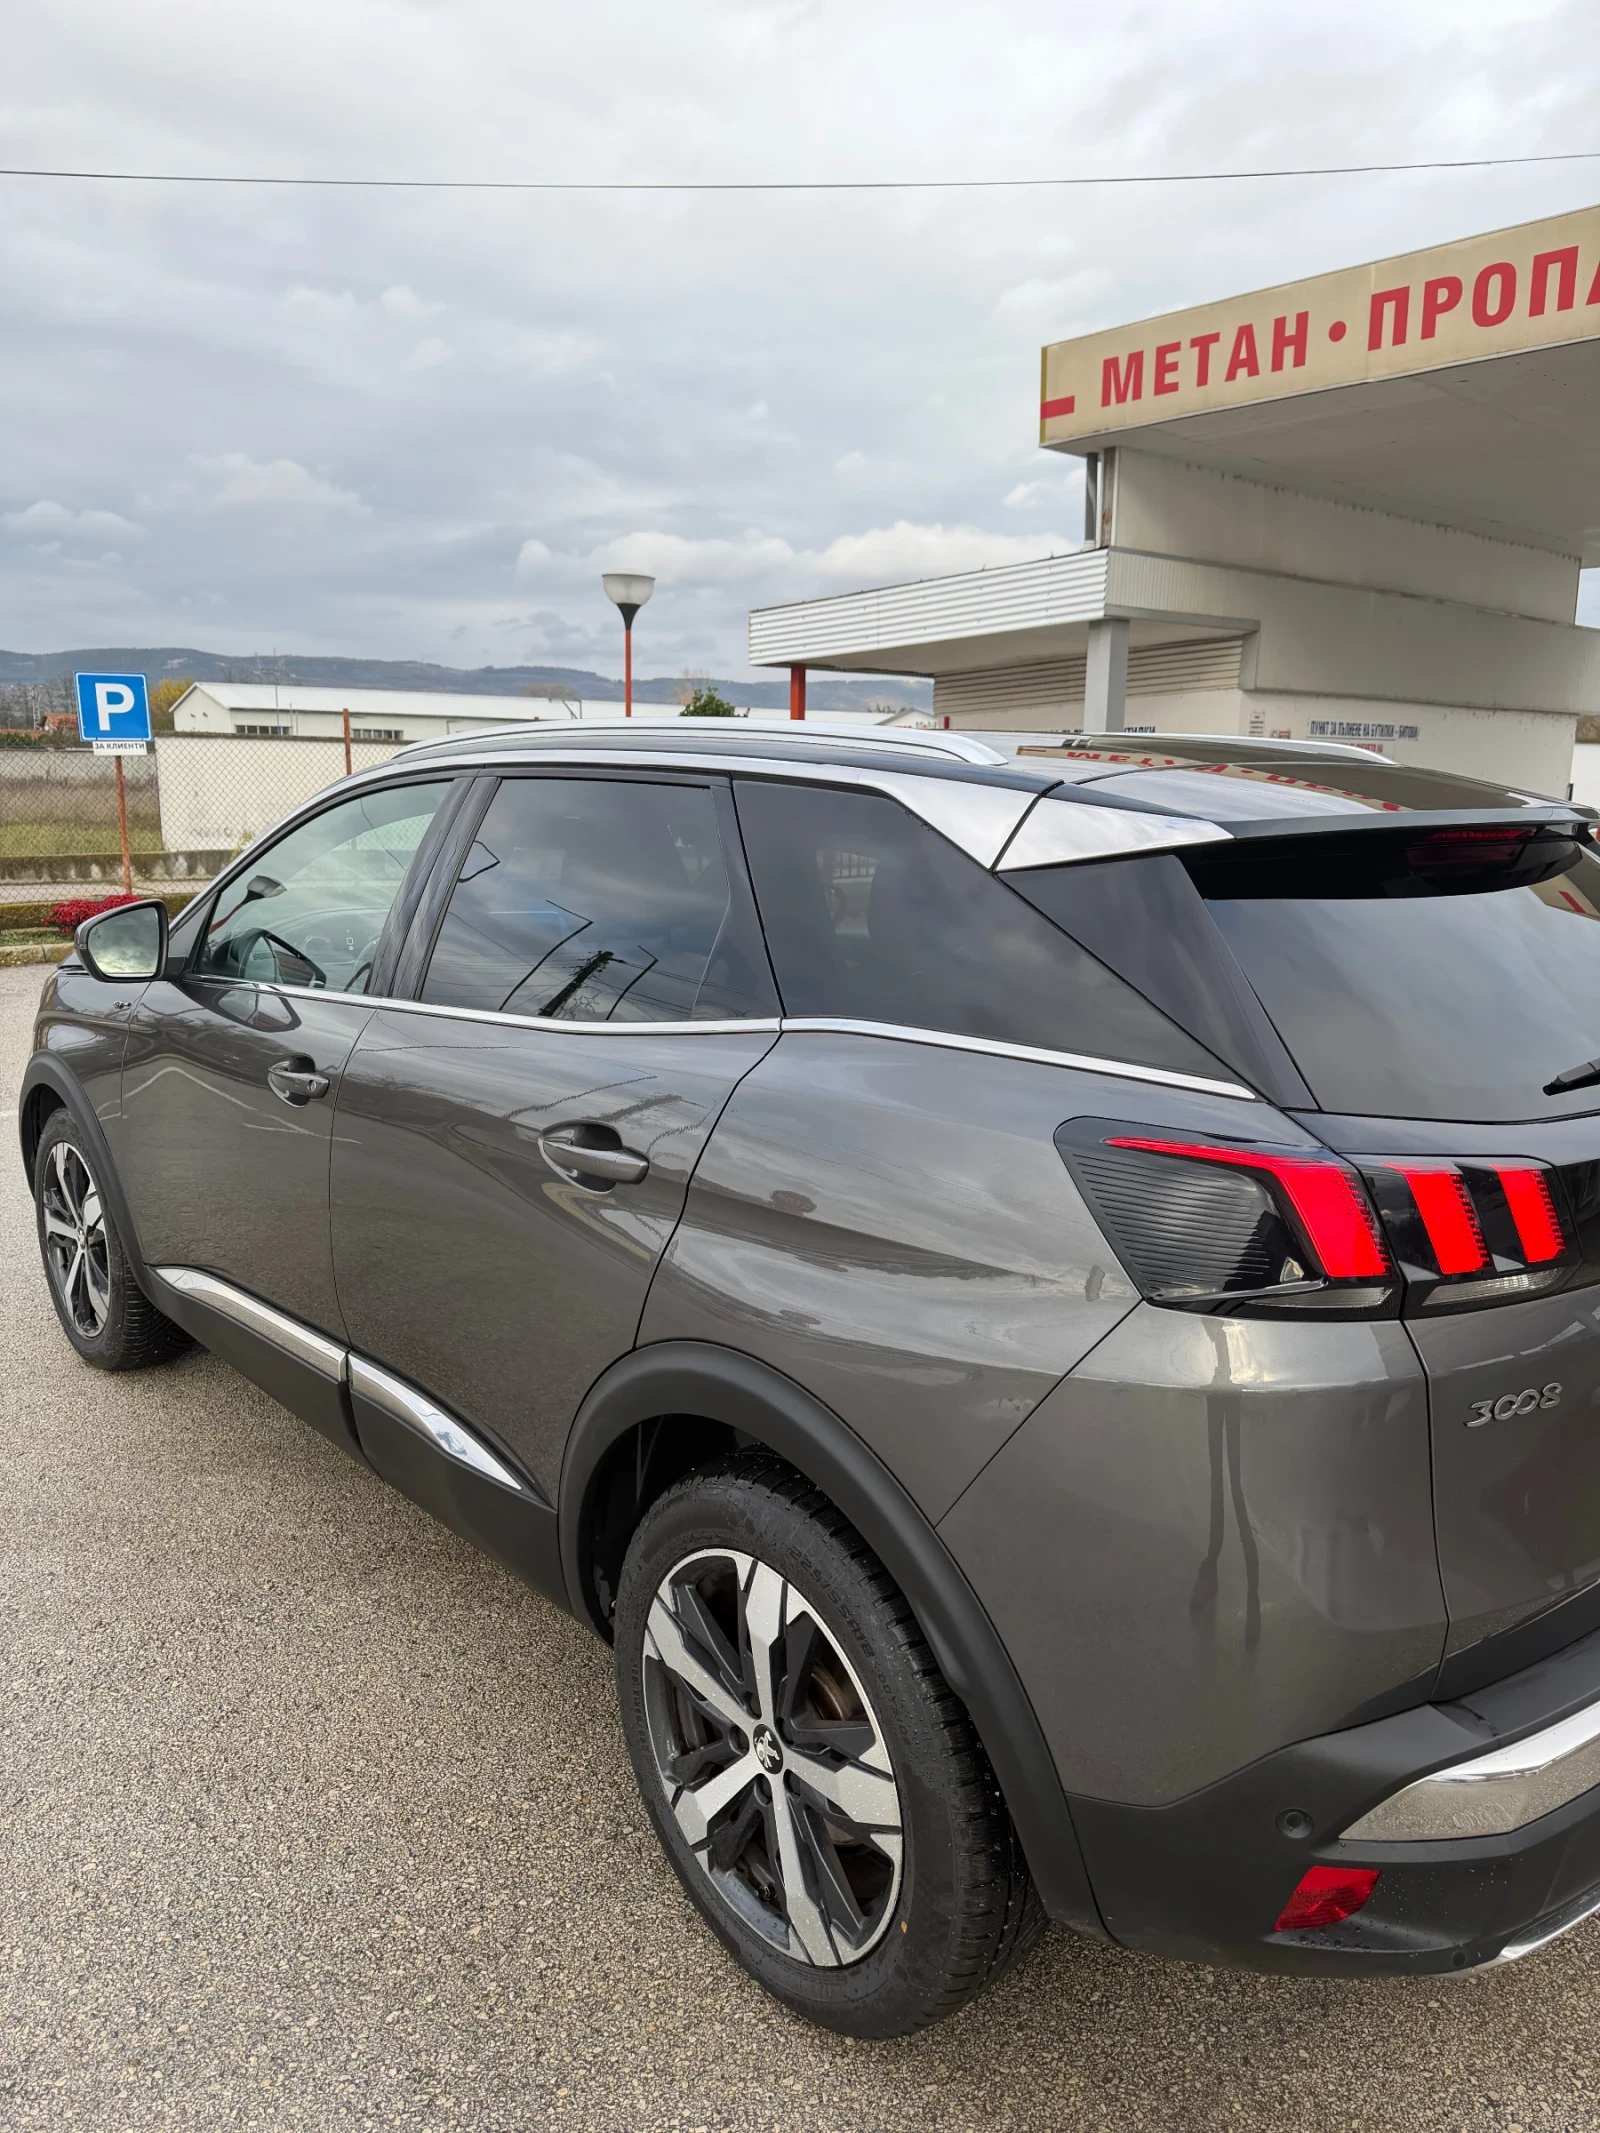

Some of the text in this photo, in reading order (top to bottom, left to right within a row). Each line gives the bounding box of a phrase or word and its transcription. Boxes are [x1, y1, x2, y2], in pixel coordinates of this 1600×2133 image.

[1101, 311, 1309, 408] МЕТАН
[95, 683, 135, 731] P
[1310, 720, 1329, 735] ПУНКТ
[1330, 721, 1337, 735] ЗА
[1463, 1382, 1563, 1427] 3008
